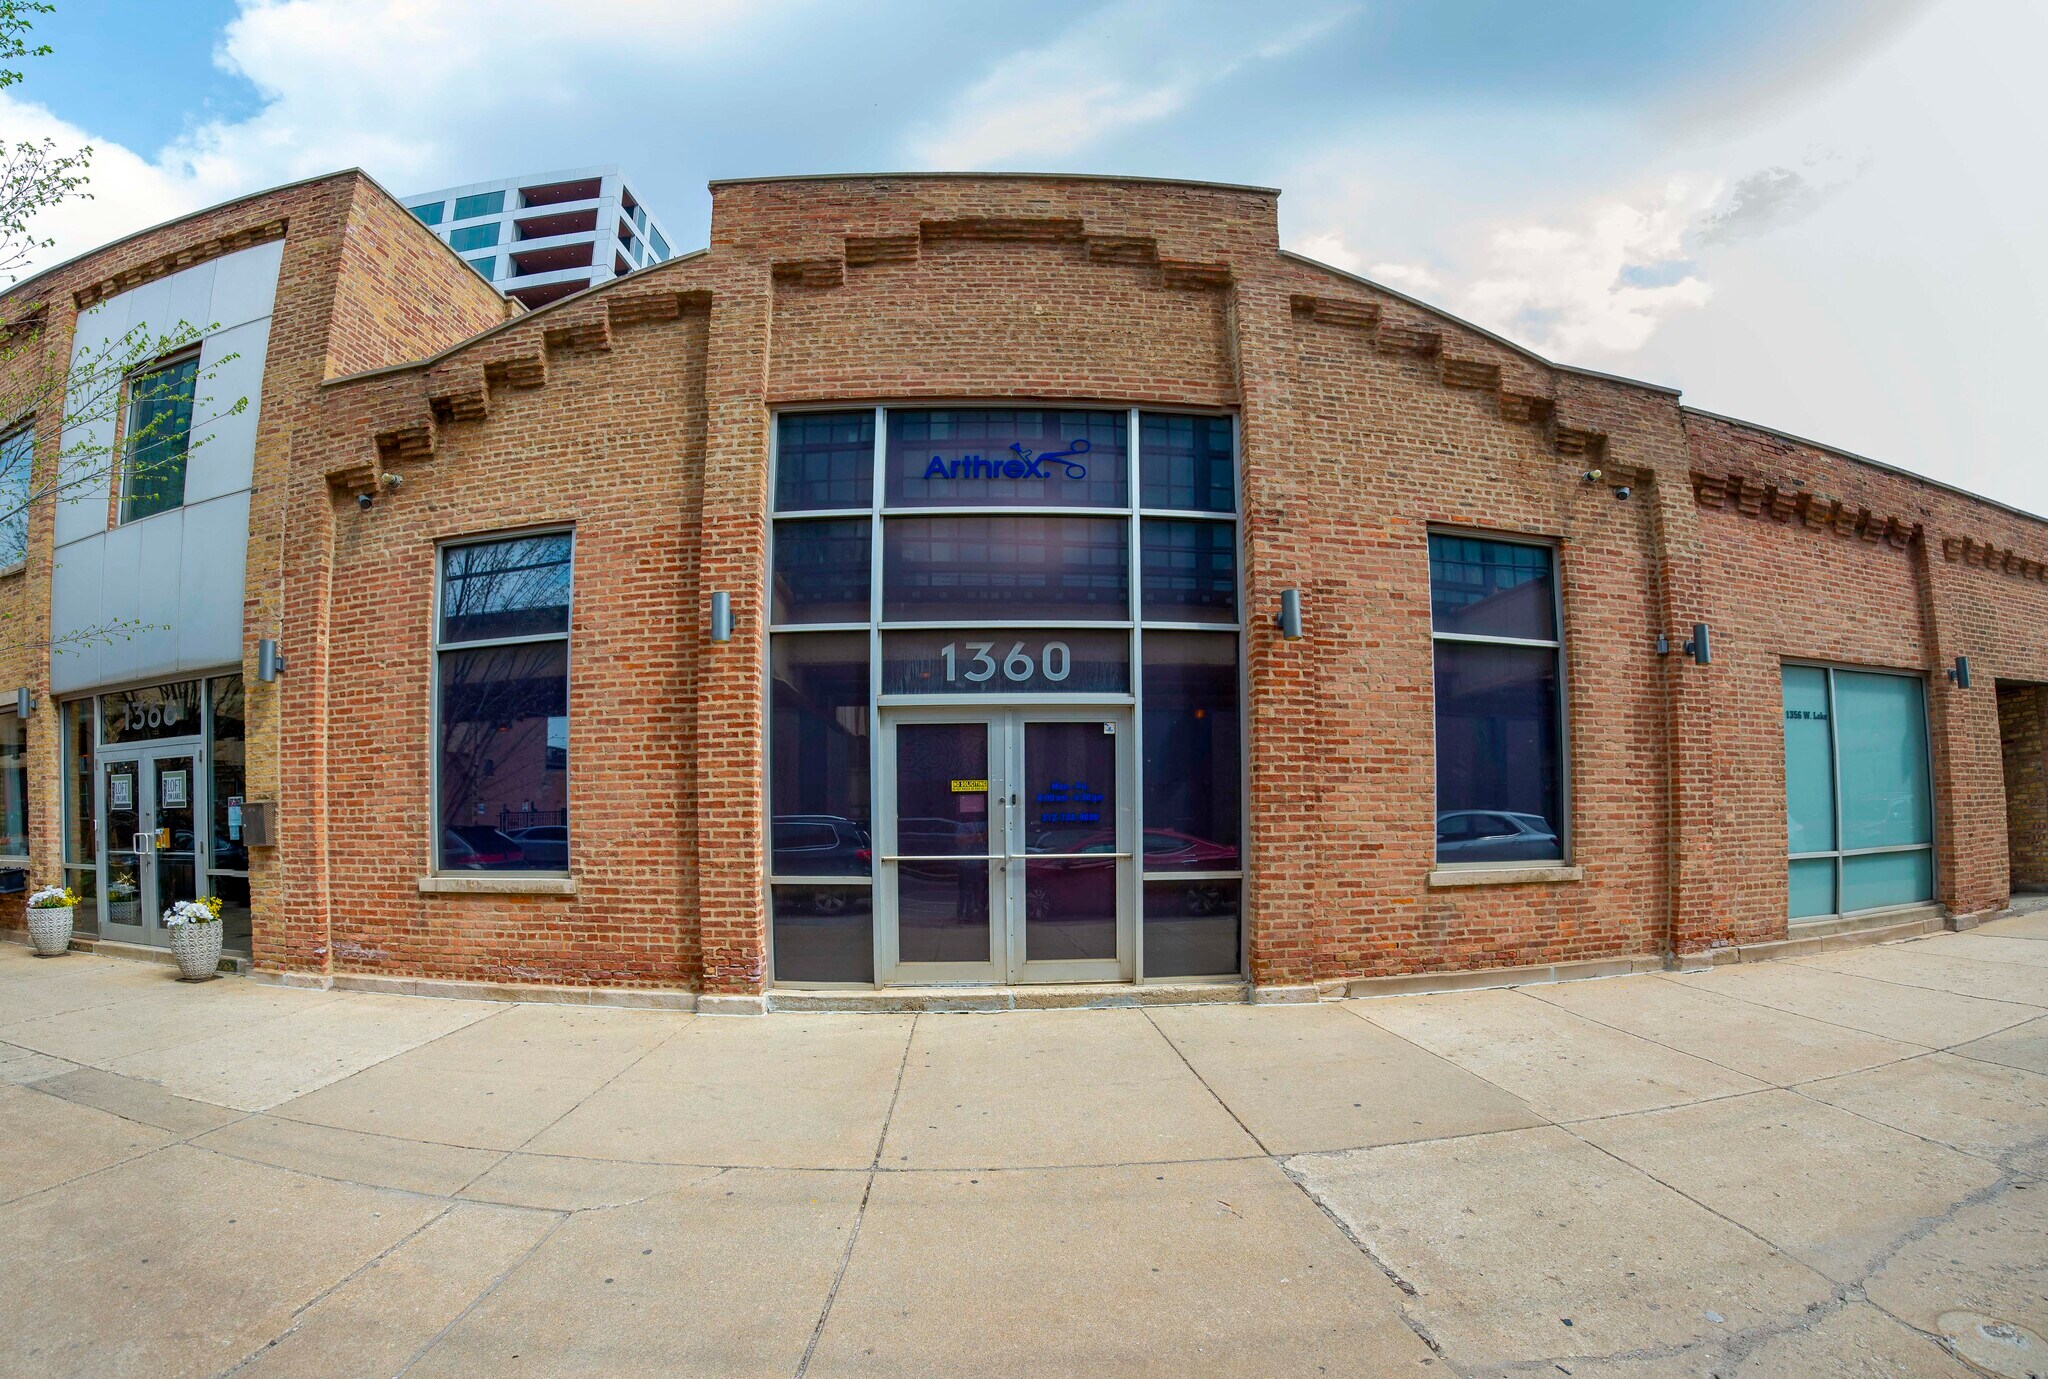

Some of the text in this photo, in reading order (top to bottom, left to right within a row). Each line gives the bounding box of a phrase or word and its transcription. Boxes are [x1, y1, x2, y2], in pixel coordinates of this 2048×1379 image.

[924, 453, 1050, 479] Arthrex
[941, 641, 1071, 682] 1360
[123, 697, 178, 730] 1366
[1786, 710, 1827, 720] 1356 W. Lake
[116, 782, 128, 795] LOFT
[167, 779, 182, 793] LOFT
